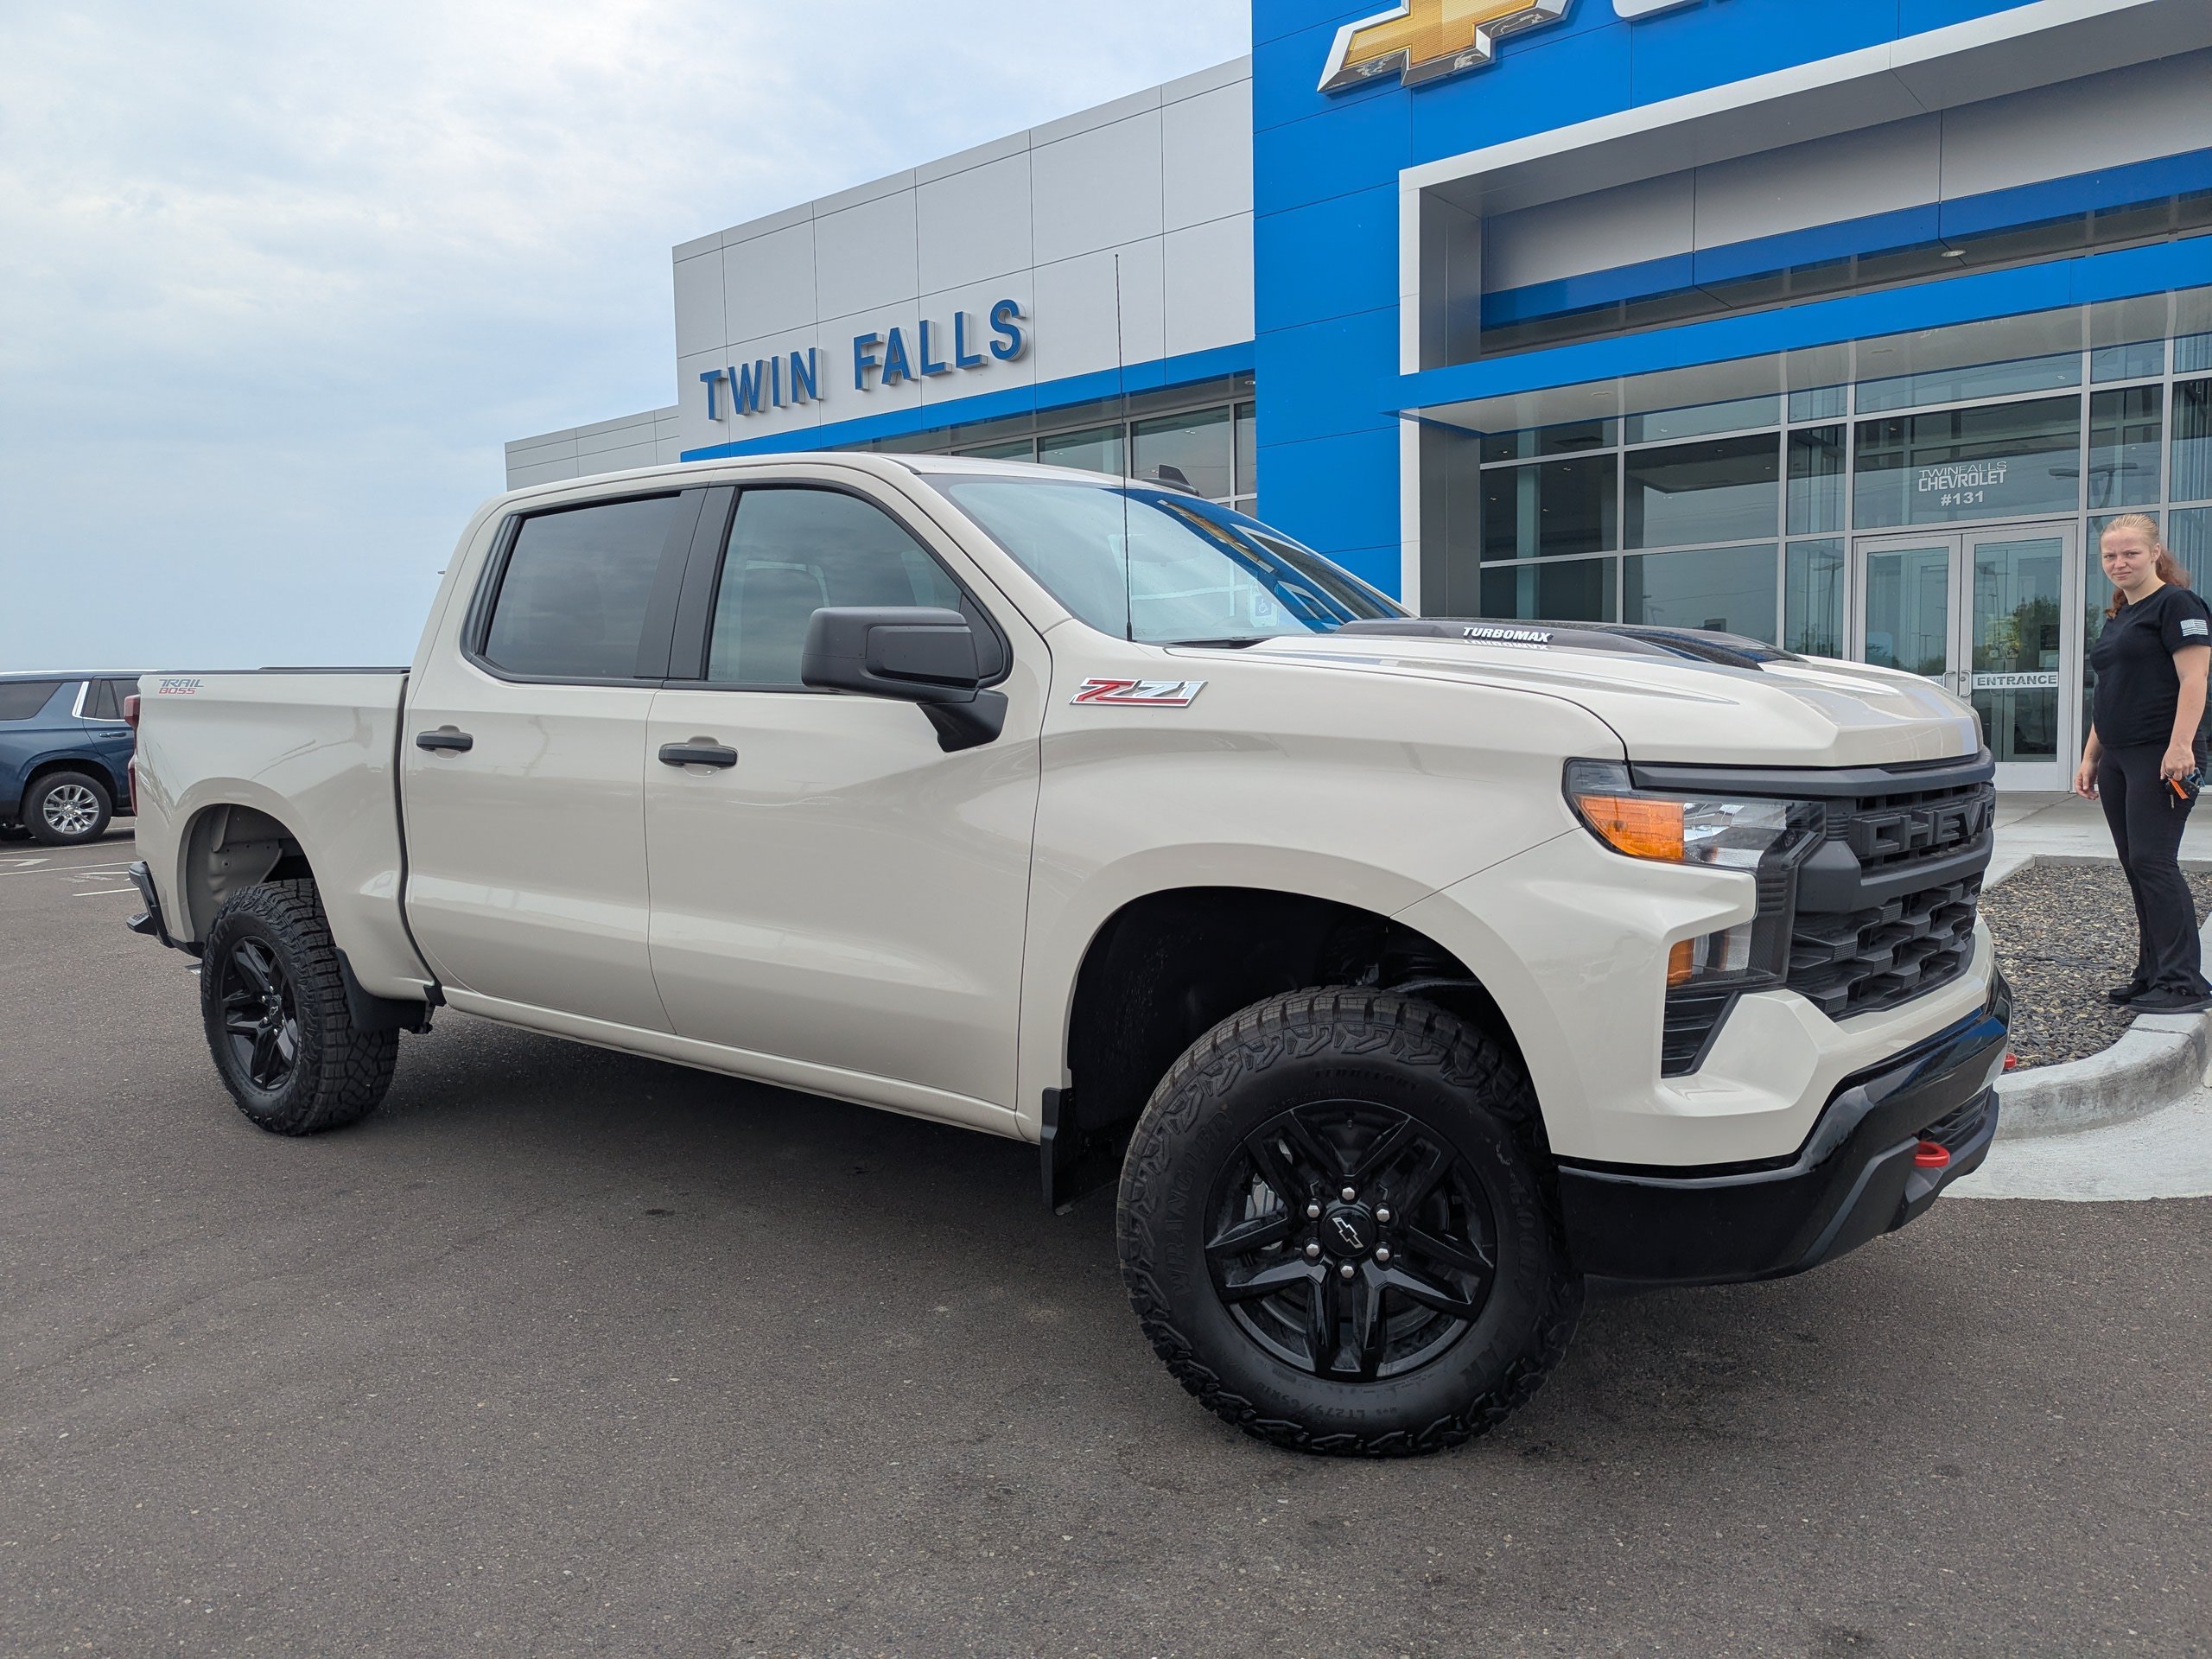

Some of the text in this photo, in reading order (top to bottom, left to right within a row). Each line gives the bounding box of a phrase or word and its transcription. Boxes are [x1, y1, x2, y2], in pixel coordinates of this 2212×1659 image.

[700, 299, 1027, 421] TWIN FALLS
[1918, 469, 2006, 492] CHEVROLET
[1941, 491, 1984, 506] #131
[1463, 626, 1553, 643] TURBOMAX
[159, 678, 204, 687] TRAIL
[1977, 675, 2057, 686] ENTRANCE
[1069, 677, 1208, 708] Z71
